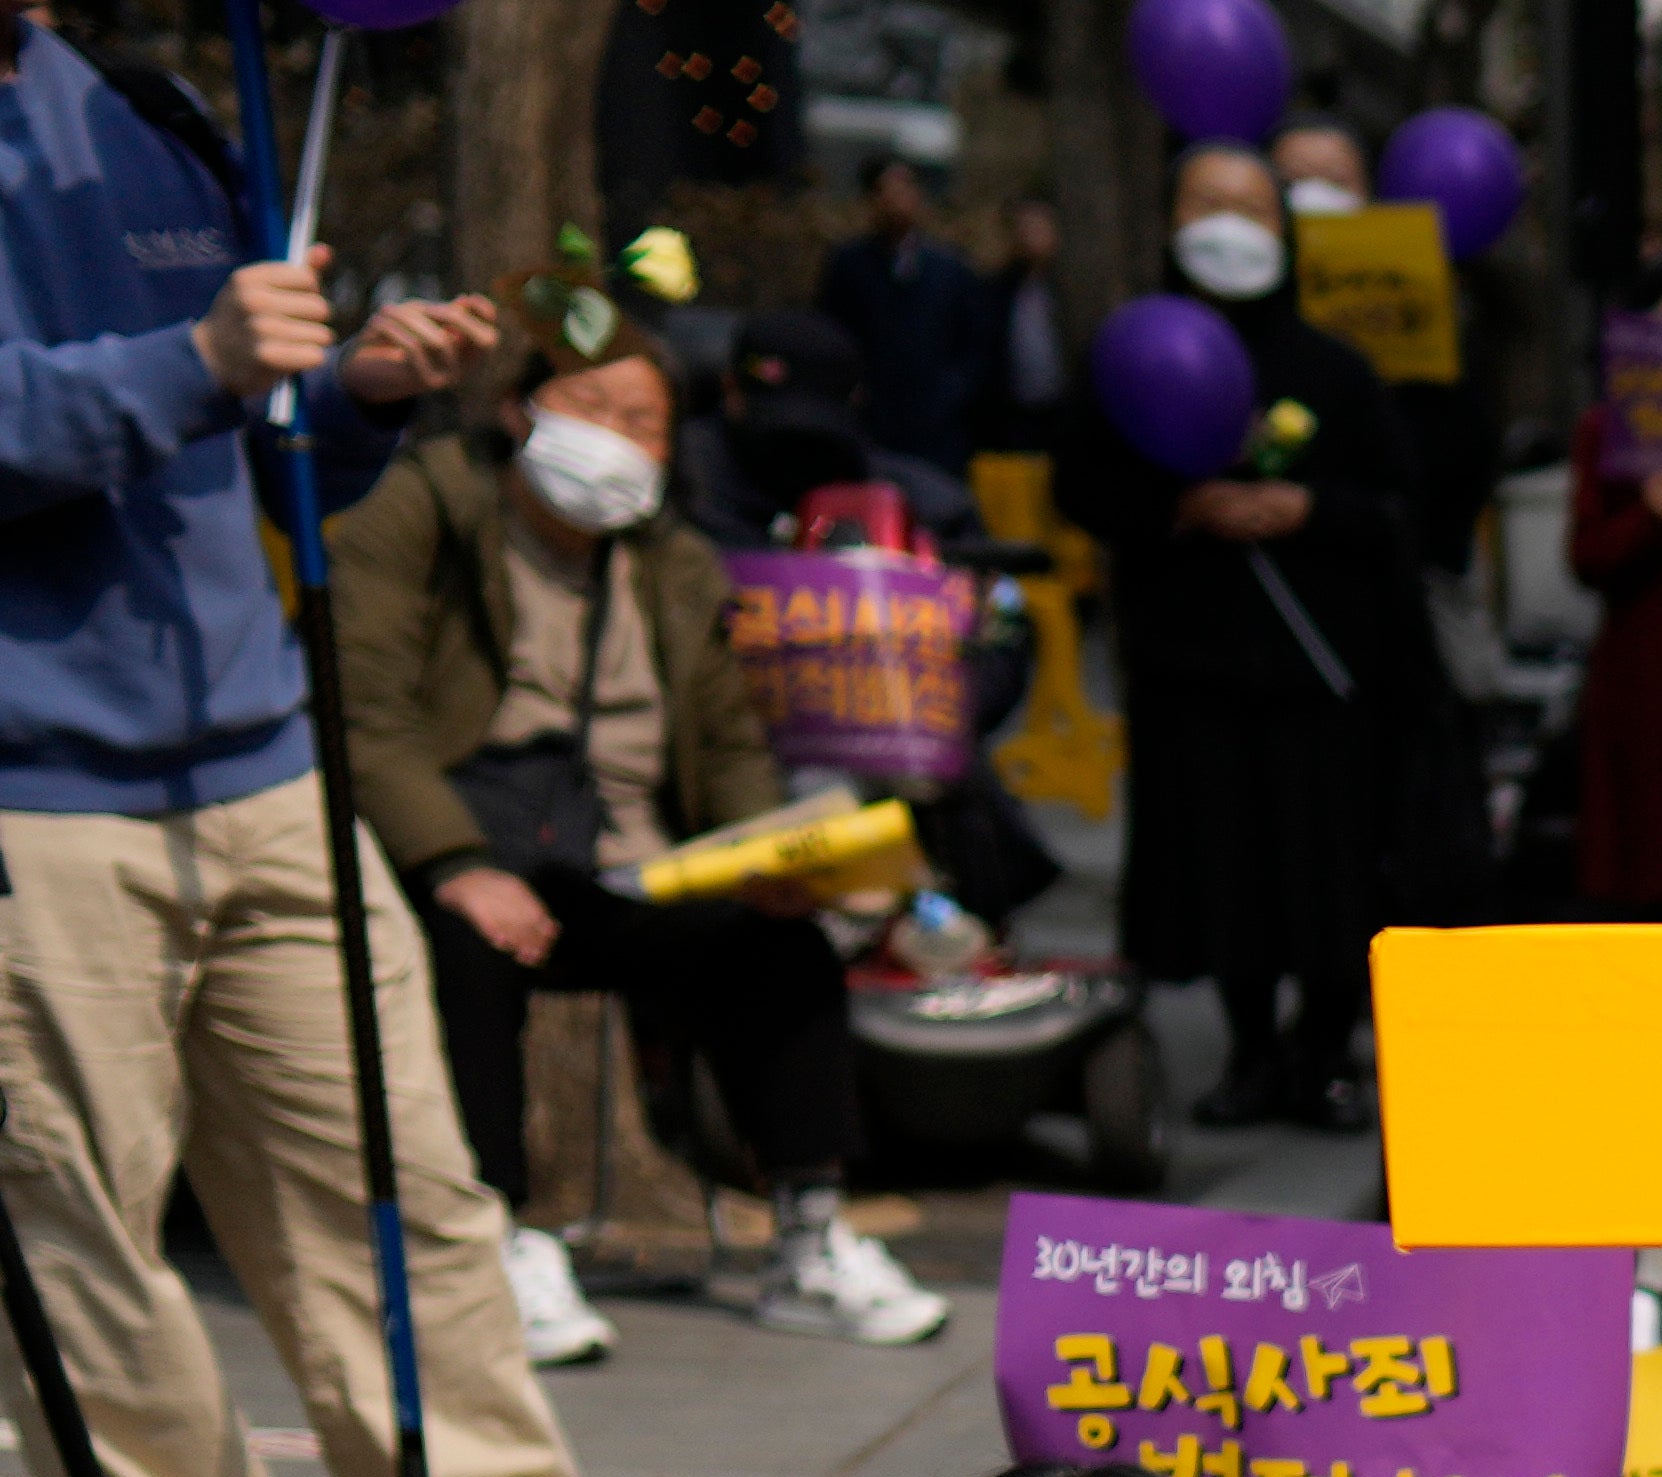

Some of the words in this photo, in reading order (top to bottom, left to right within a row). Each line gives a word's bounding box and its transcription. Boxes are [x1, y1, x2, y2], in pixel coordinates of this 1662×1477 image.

[1032, 1236, 1206, 1297] 30년간의
[1221, 1251, 1307, 1311] 외침
[1046, 1333, 1457, 1449] 공식사죄
